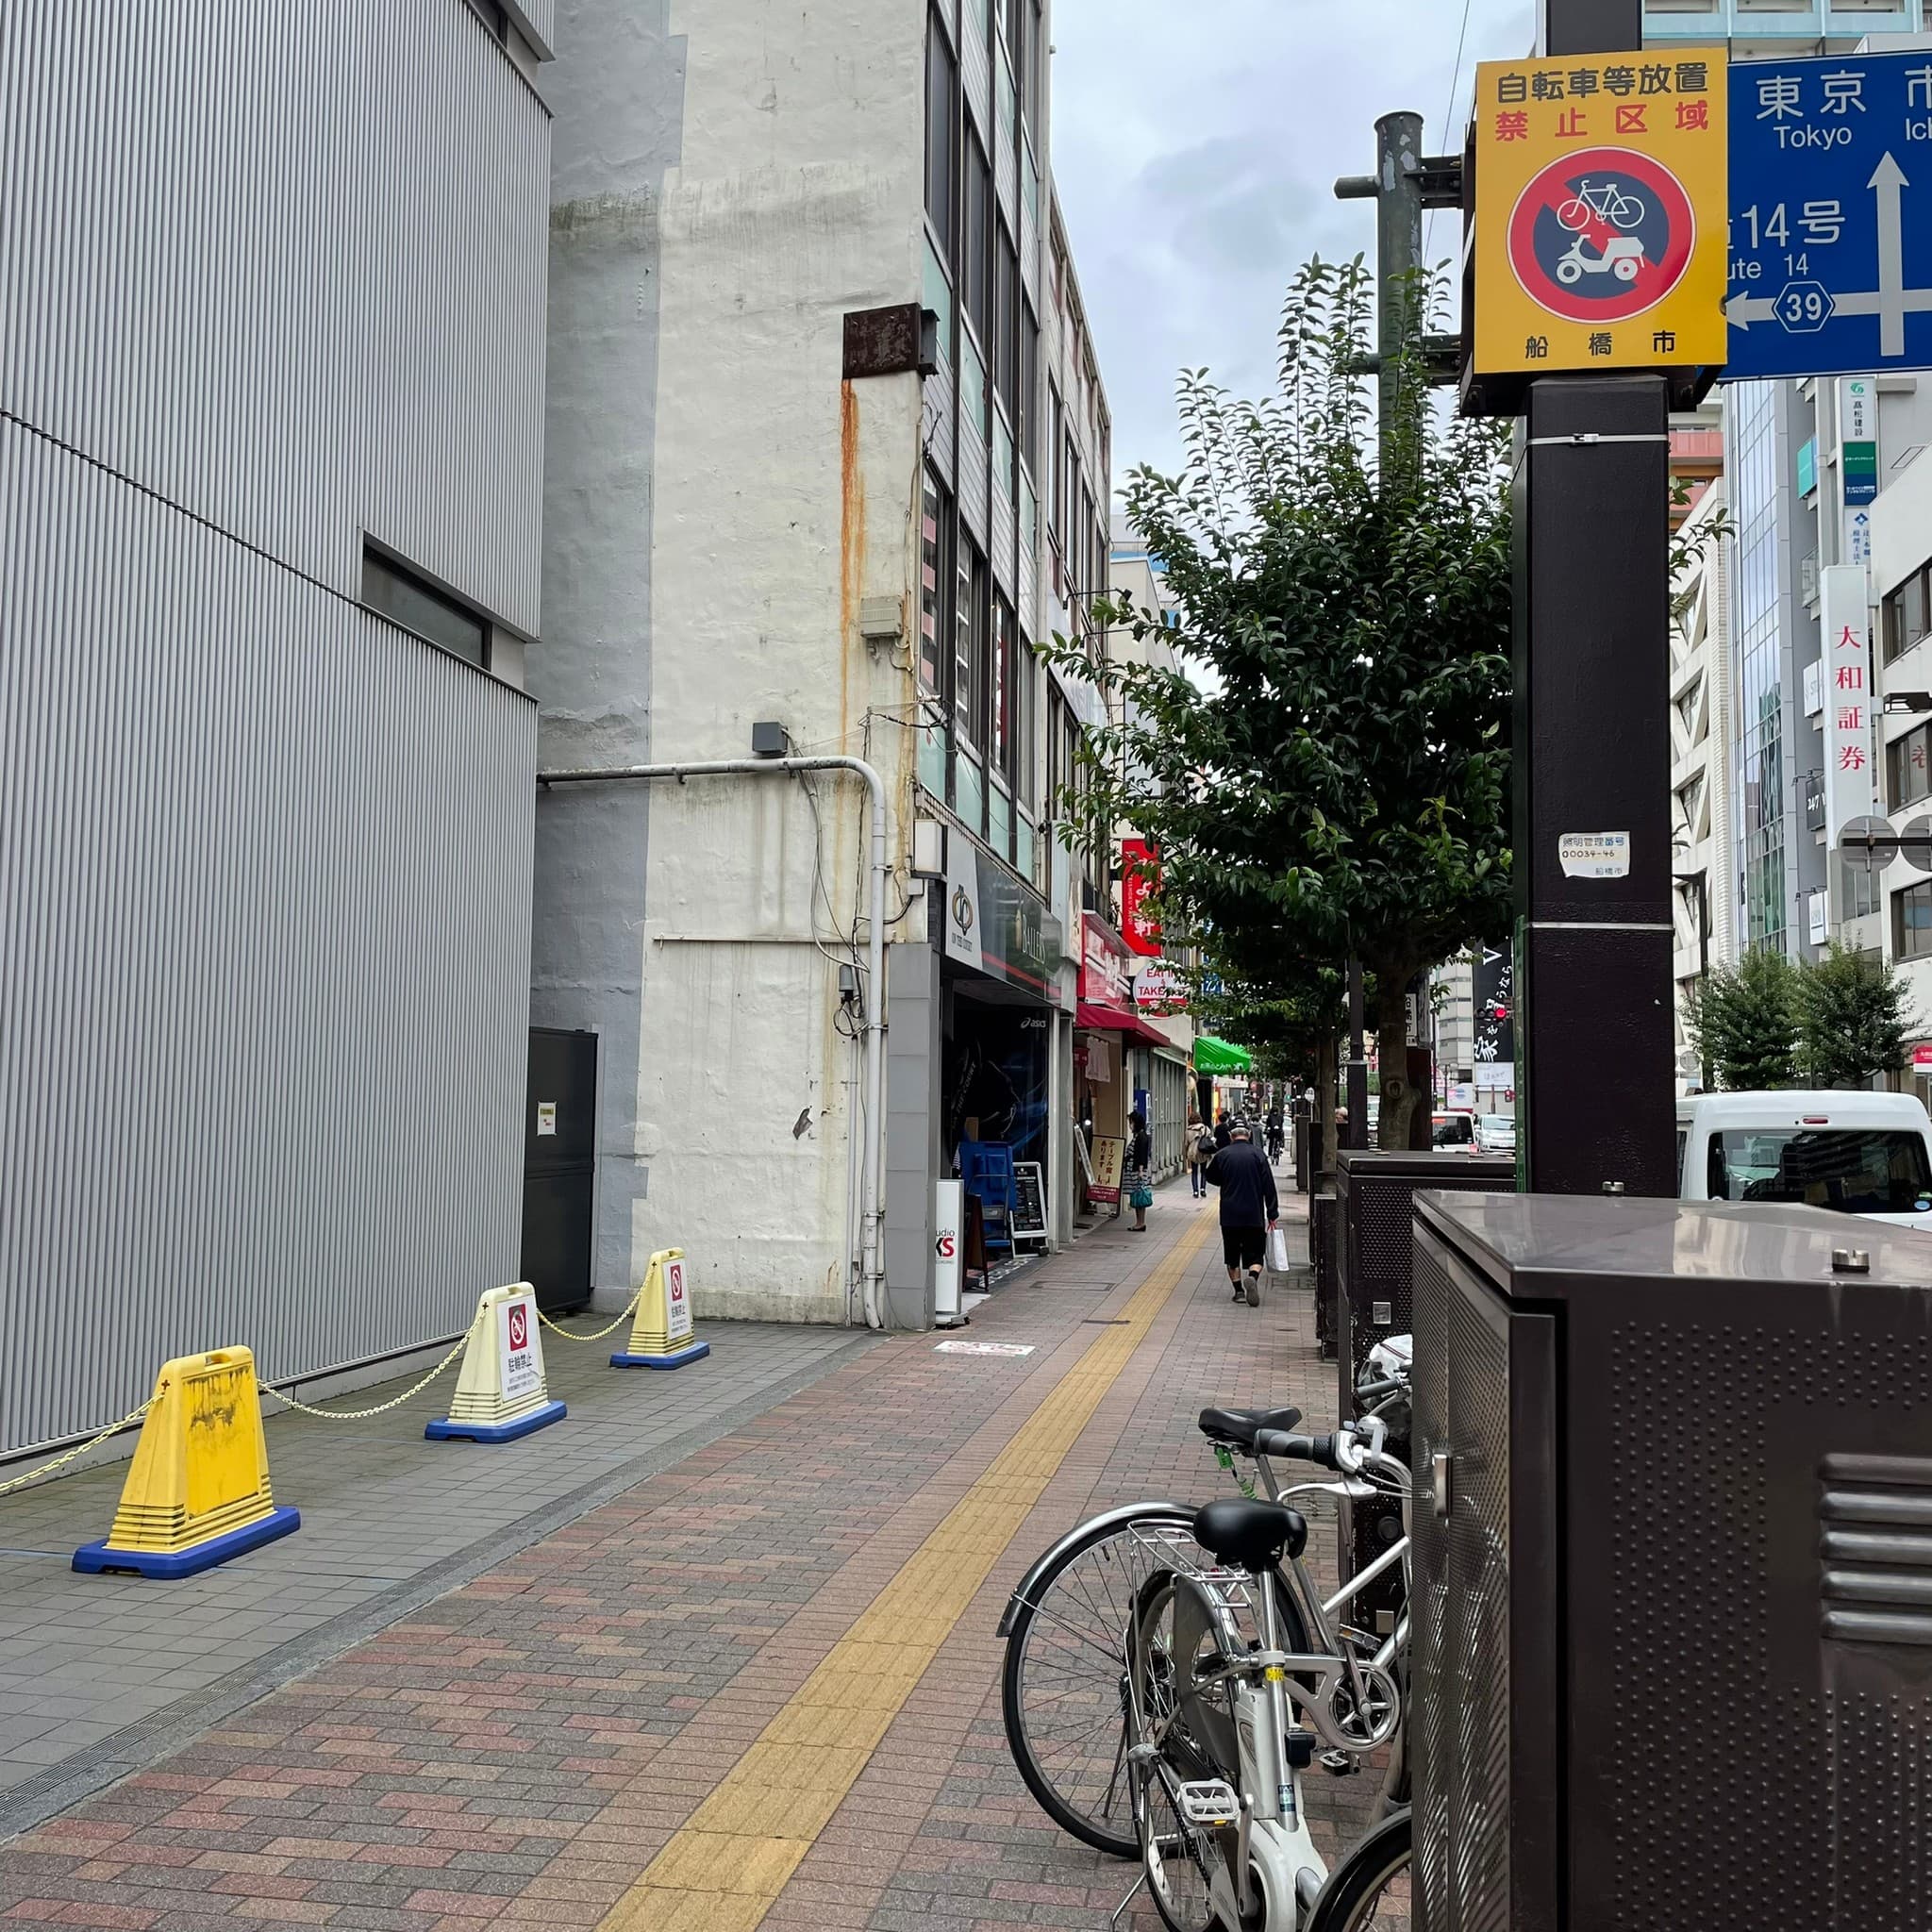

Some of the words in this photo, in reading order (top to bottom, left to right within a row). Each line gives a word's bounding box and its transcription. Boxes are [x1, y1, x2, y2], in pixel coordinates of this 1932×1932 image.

[1497, 62, 1708, 104] 自転車等放置
[1756, 70, 1866, 120] 東京
[1495, 100, 1708, 142] 禁止区域
[1774, 125, 1853, 151] Tokyo
[1728, 200, 1845, 249] 14号
[1784, 253, 1809, 276] 14
[1786, 292, 1823, 322] 39
[1524, 330, 1676, 359] 船橋市
[1834, 625, 1865, 771] 大和証券
[936, 1227, 955, 1236] udio
